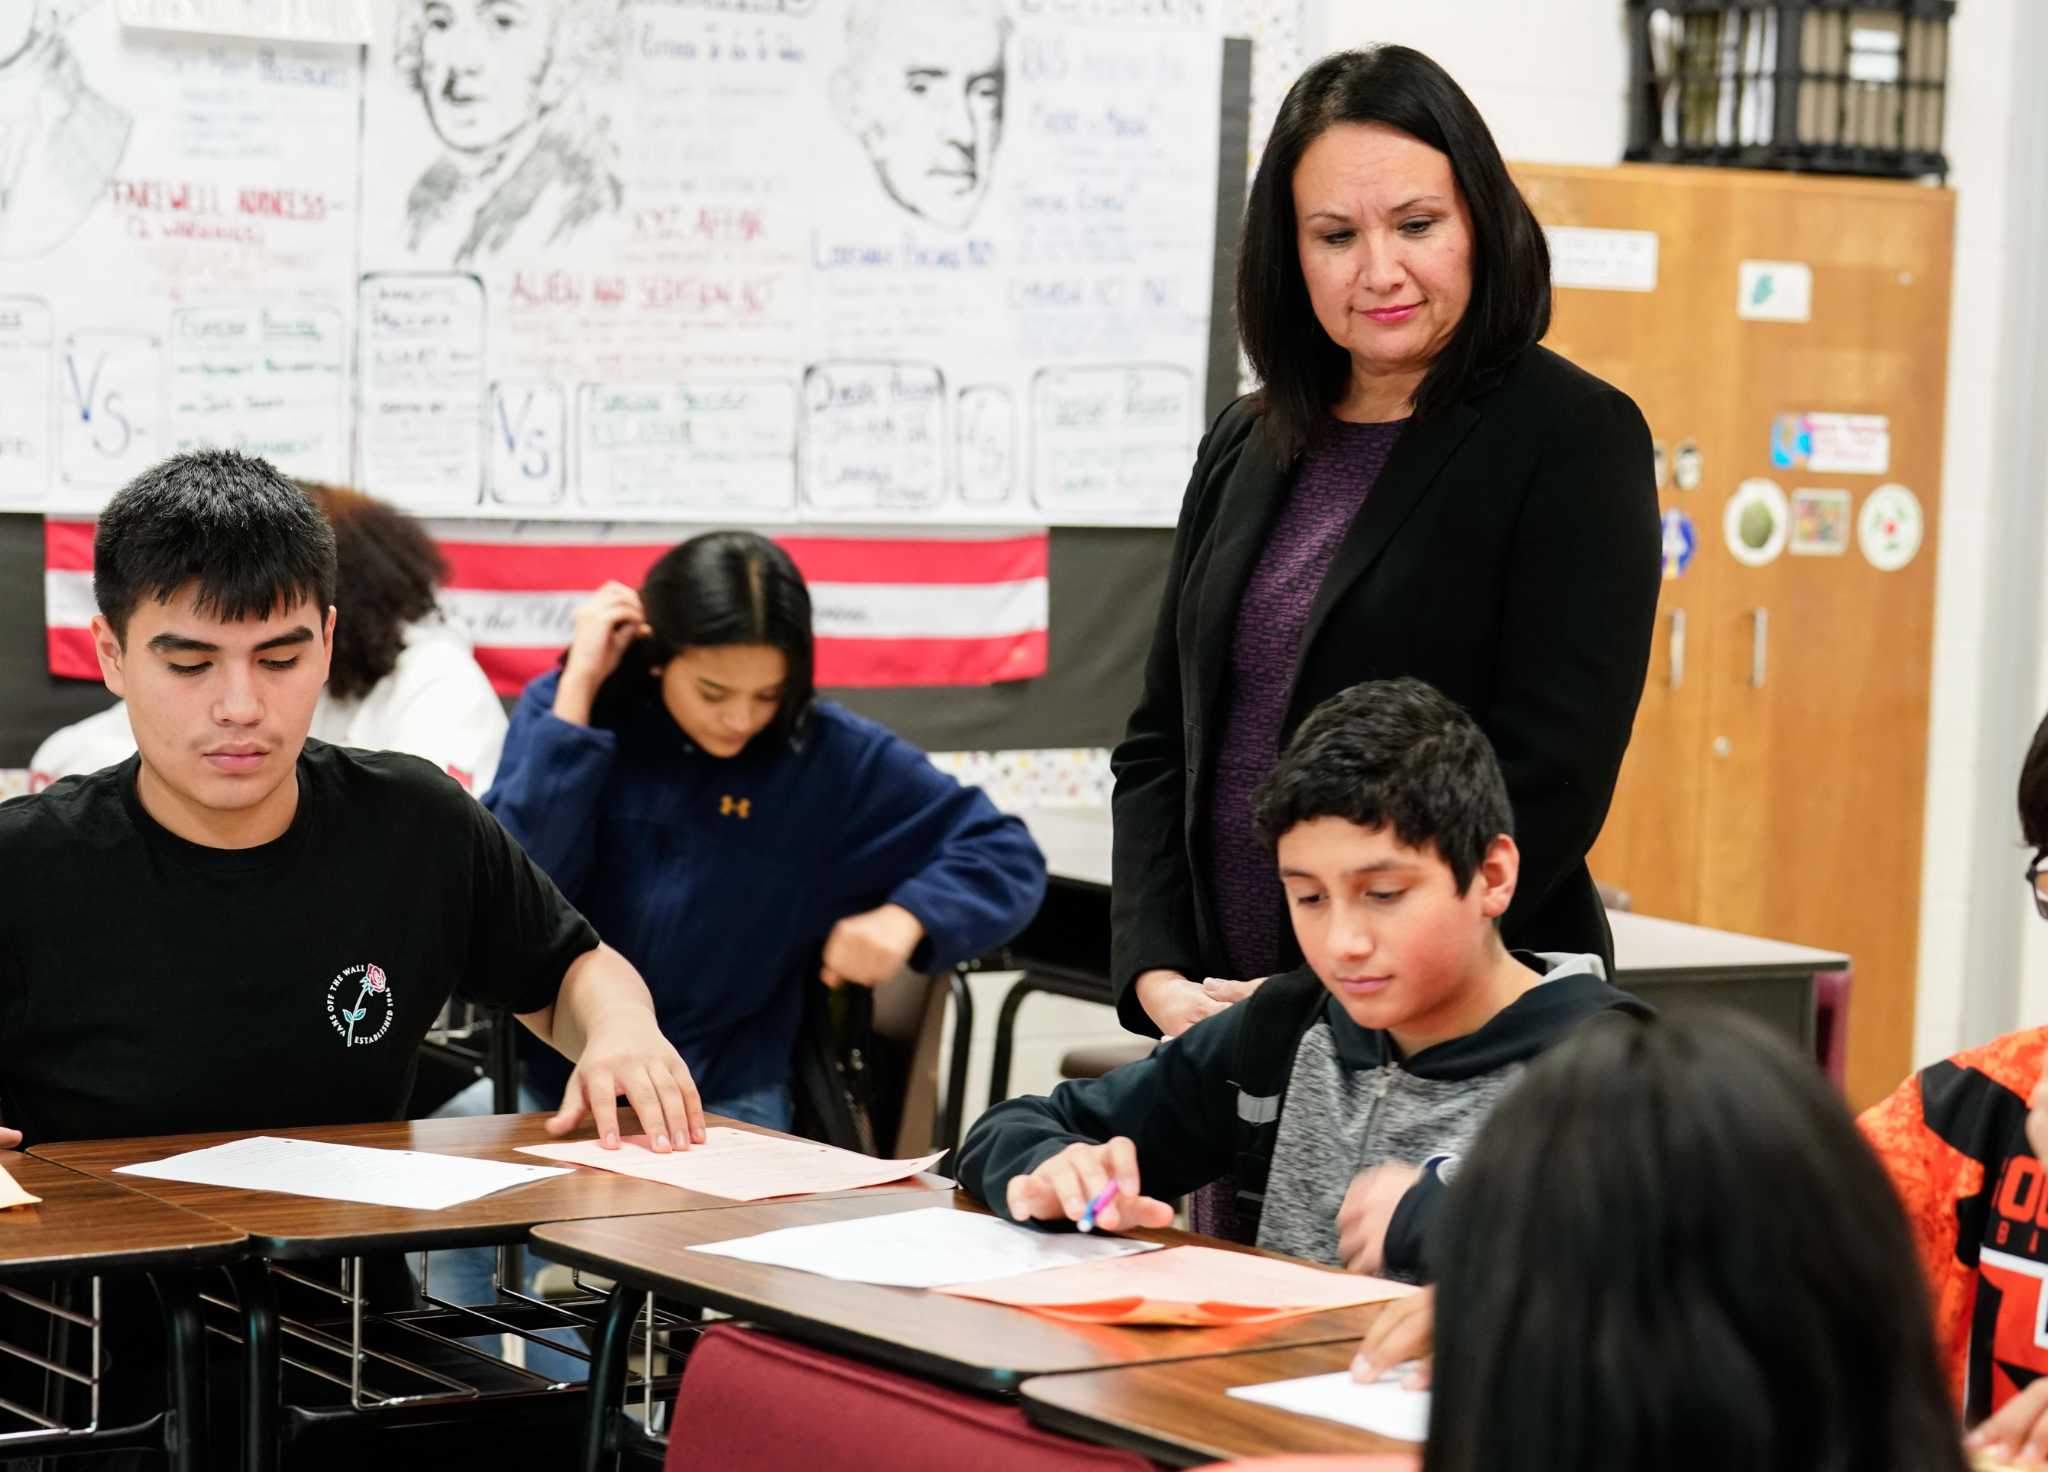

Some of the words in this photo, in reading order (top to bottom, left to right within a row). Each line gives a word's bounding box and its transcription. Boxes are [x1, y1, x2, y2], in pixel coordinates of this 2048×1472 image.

[342, 964, 366, 977] WALL
[329, 974, 344, 991] THE
[327, 993, 335, 1012] OFF
[329, 1014, 346, 1037] VANS
[354, 1009, 394, 1045] ESTABLISHED
